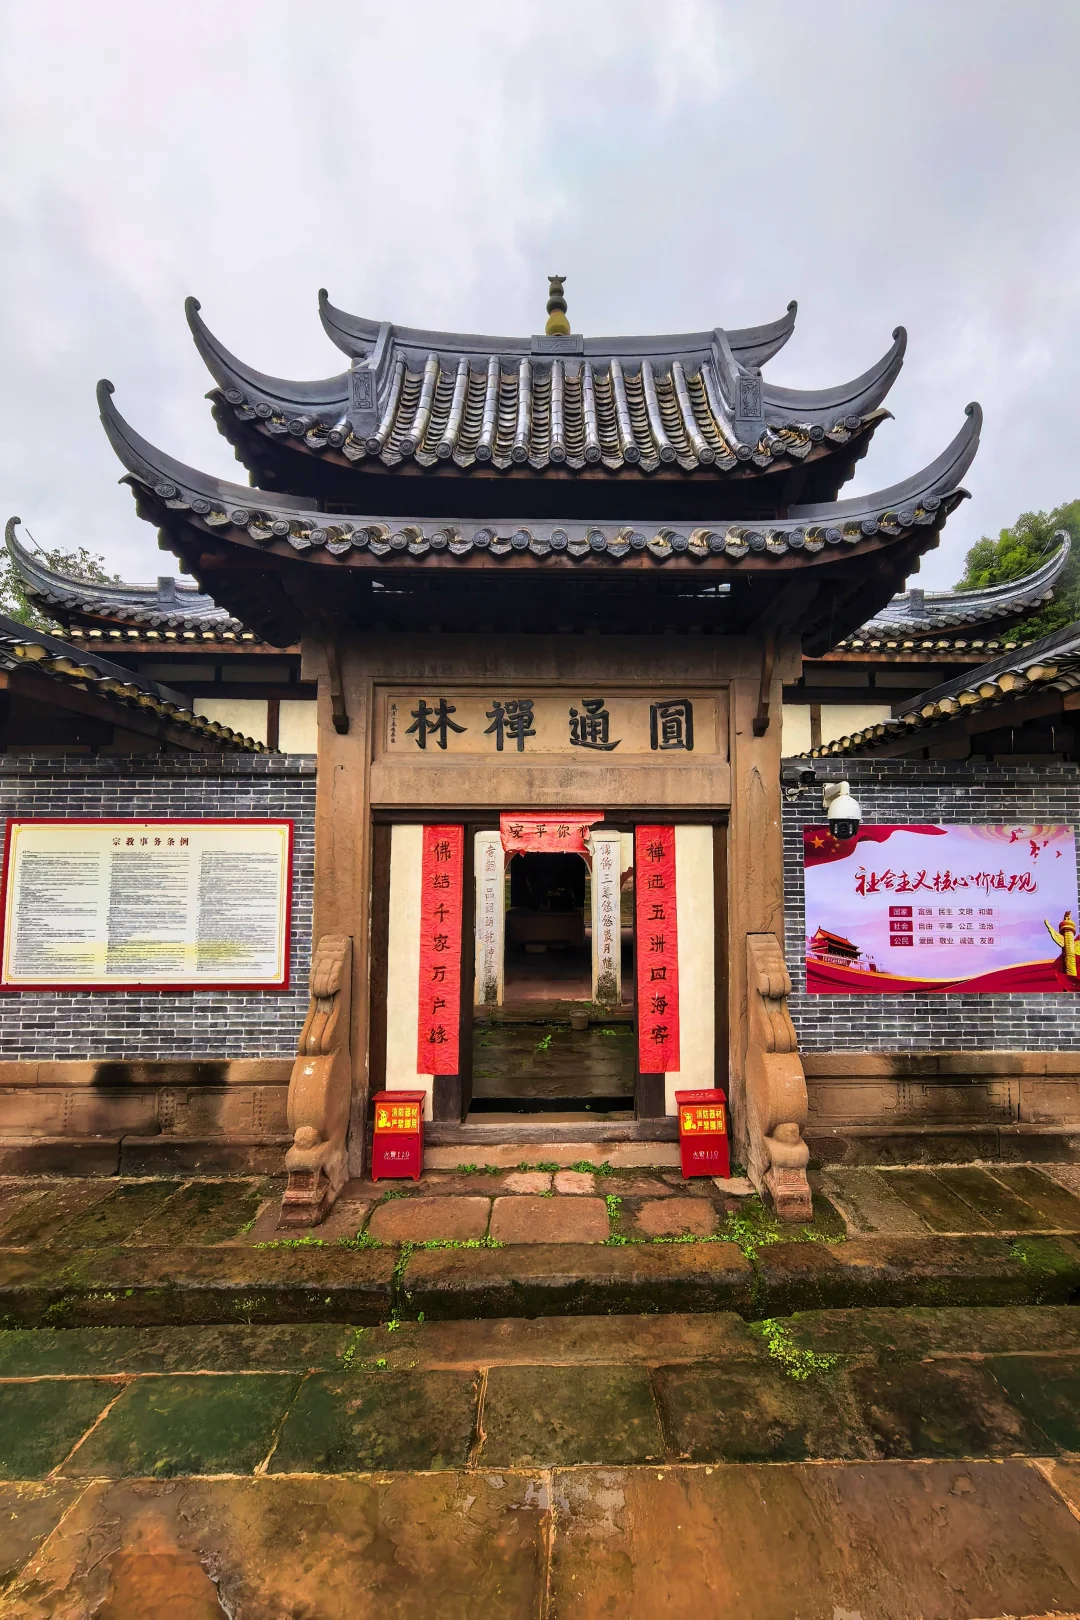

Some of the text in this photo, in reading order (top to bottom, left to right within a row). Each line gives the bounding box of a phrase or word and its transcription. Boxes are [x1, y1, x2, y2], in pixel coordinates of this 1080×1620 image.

[112, 837, 189, 847] 宗教事务条例
[854, 865, 1037, 897] 社会主义核心价值观
[893, 908, 993, 916] 国家 富强 民主 文明 和谐
[893, 922, 994, 930] 社会 自由 平等 公正 法治
[894, 937, 995, 945] 公民 爱国 敬业 诚信 友善
[391, 1107, 418, 1117] 消防器材
[696, 1109, 722, 1119] 消防器材
[693, 1150, 719, 1158] 火警119
